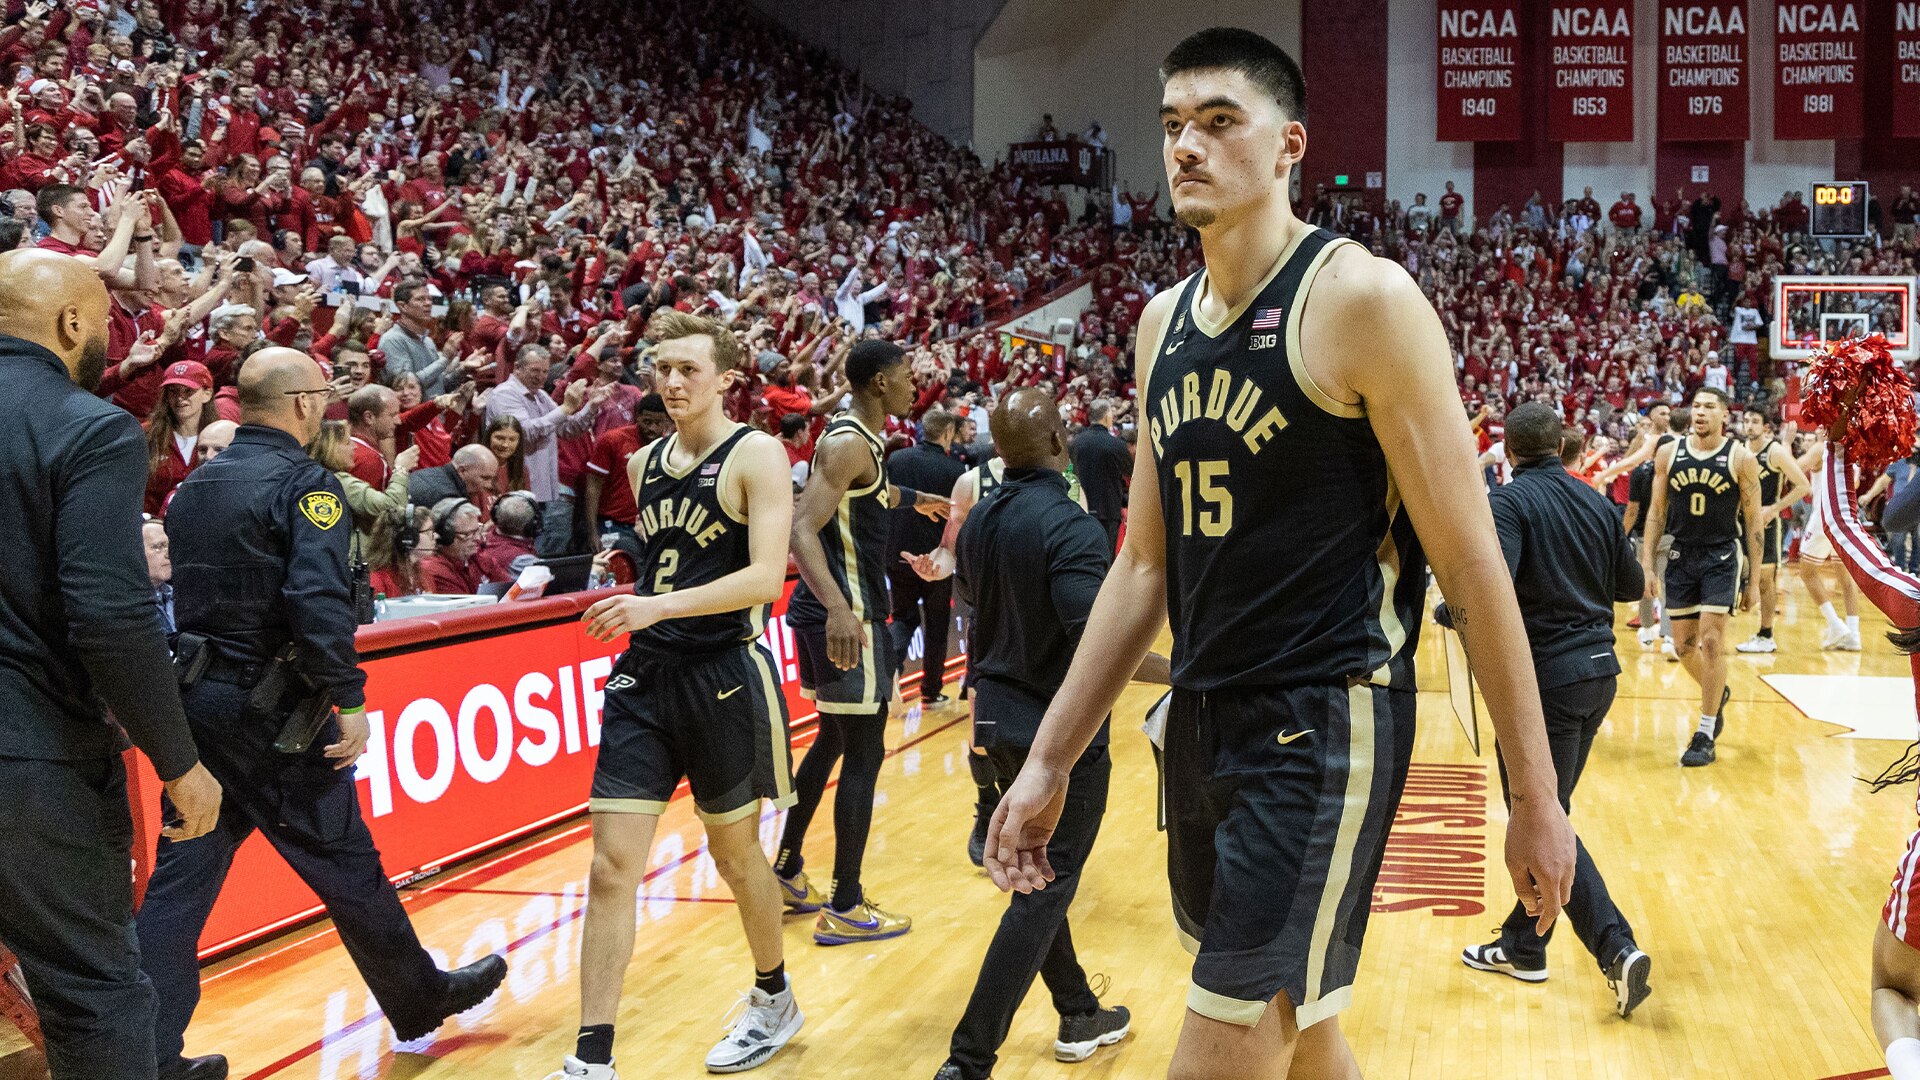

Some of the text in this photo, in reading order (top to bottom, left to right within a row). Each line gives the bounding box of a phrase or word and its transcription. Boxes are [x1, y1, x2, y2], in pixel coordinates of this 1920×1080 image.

[1441, 9, 1518, 38] NCAA
[1551, 7, 1631, 37] NCAA
[1665, 6, 1746, 36] NCAA
[1778, 4, 1860, 34] NCAA
[1896, 2, 1920, 31] N
[1442, 47, 1515, 66] BASKETBALL
[1553, 46, 1627, 65] BASKETBALL
[1666, 45, 1743, 64] BASKETBALL
[1780, 42, 1857, 62] BASKETBALL
[1898, 40, 1920, 60] BAS
[1444, 70, 1512, 88] CHAMPIONS
[1556, 69, 1625, 88] CHAMPIONS
[1669, 68, 1740, 87] CHAMPIONS
[1782, 65, 1854, 85] CHAMPIONS
[1462, 98, 1496, 116] 1940
[1573, 97, 1608, 116] 1953
[1689, 96, 1723, 115] 1976
[1803, 94, 1834, 113] 1981
[1014, 147, 1070, 165] INDIANA
[1150, 368, 1289, 460] PURDUE
[1670, 467, 1731, 495] PURDUE
[307, 495, 337, 504] POLICE
[1174, 460, 1233, 537] 15
[1690, 492, 1706, 516] 0
[653, 549, 680, 593] 2
[354, 651, 617, 818] HOOSIE
[395, 866, 441, 889] DAKTRONICS
